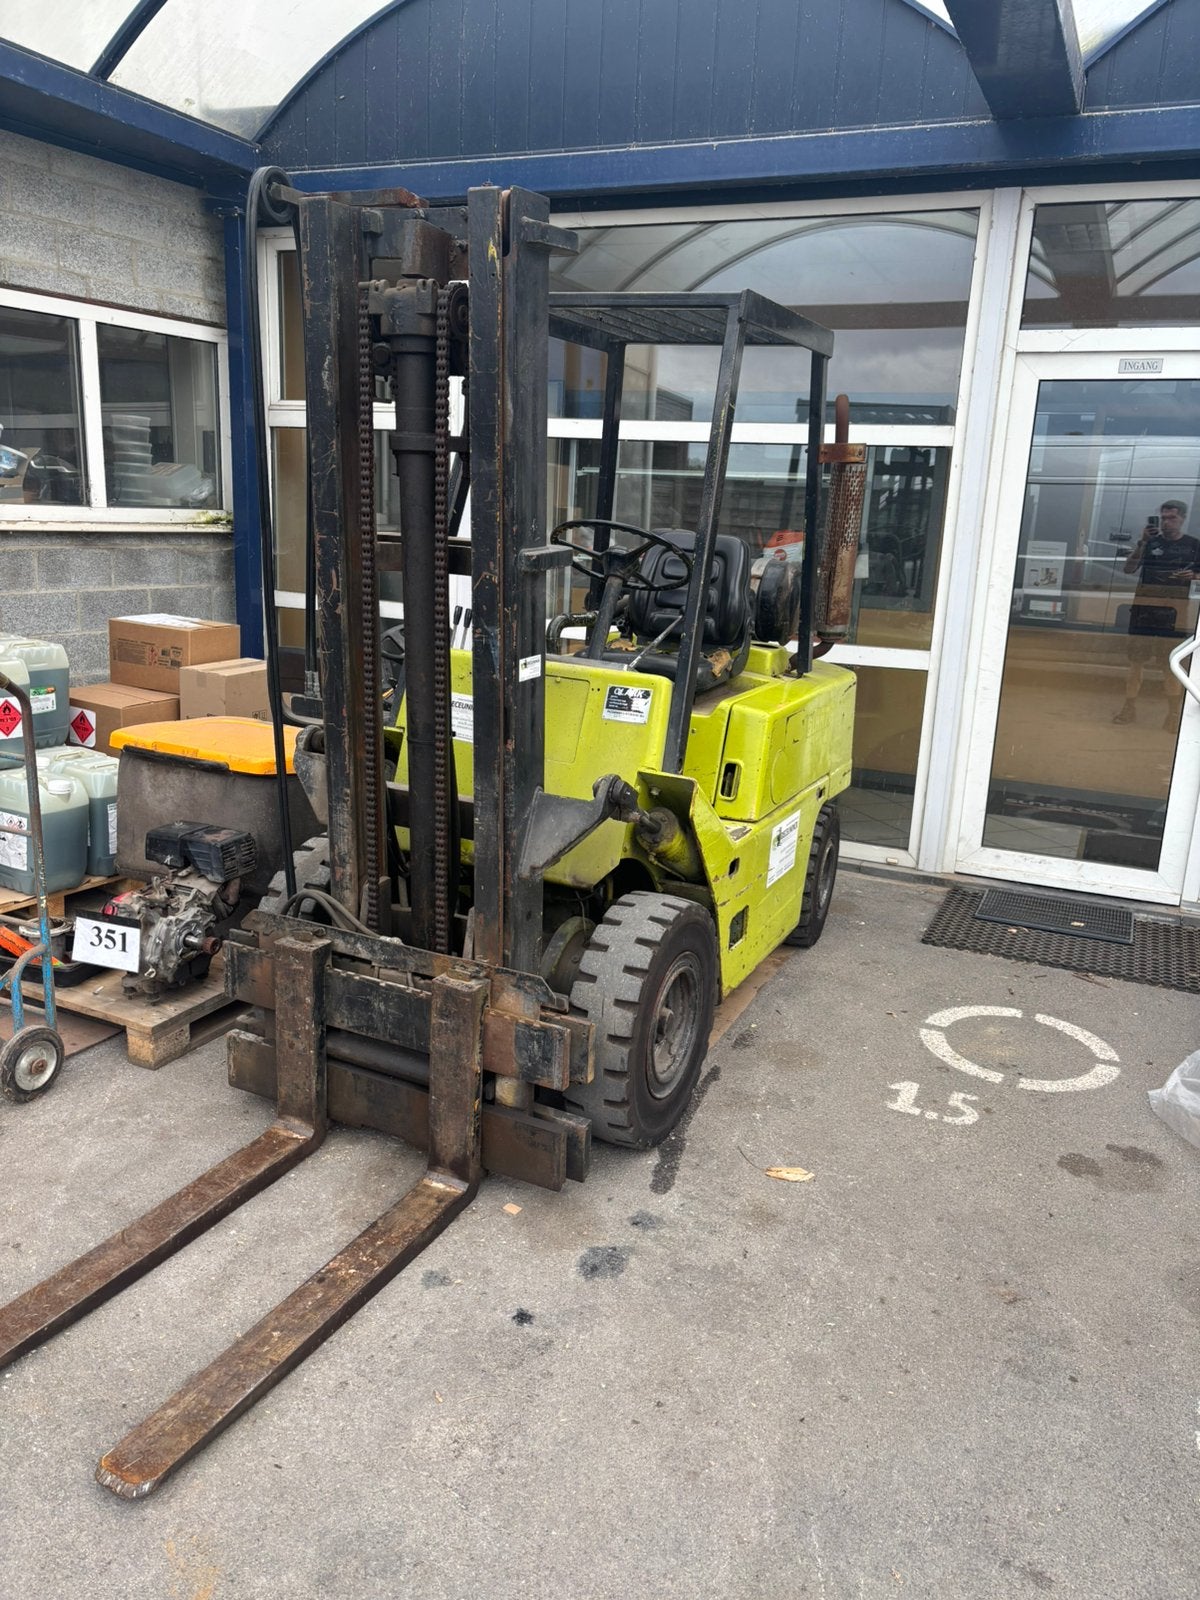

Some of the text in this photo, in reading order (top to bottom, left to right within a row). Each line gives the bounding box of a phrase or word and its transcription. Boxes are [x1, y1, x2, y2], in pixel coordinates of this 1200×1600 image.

[1123, 361, 1159, 371] INGANG
[89, 925, 129, 953] 351
[884, 1081, 980, 1125] 1.5
